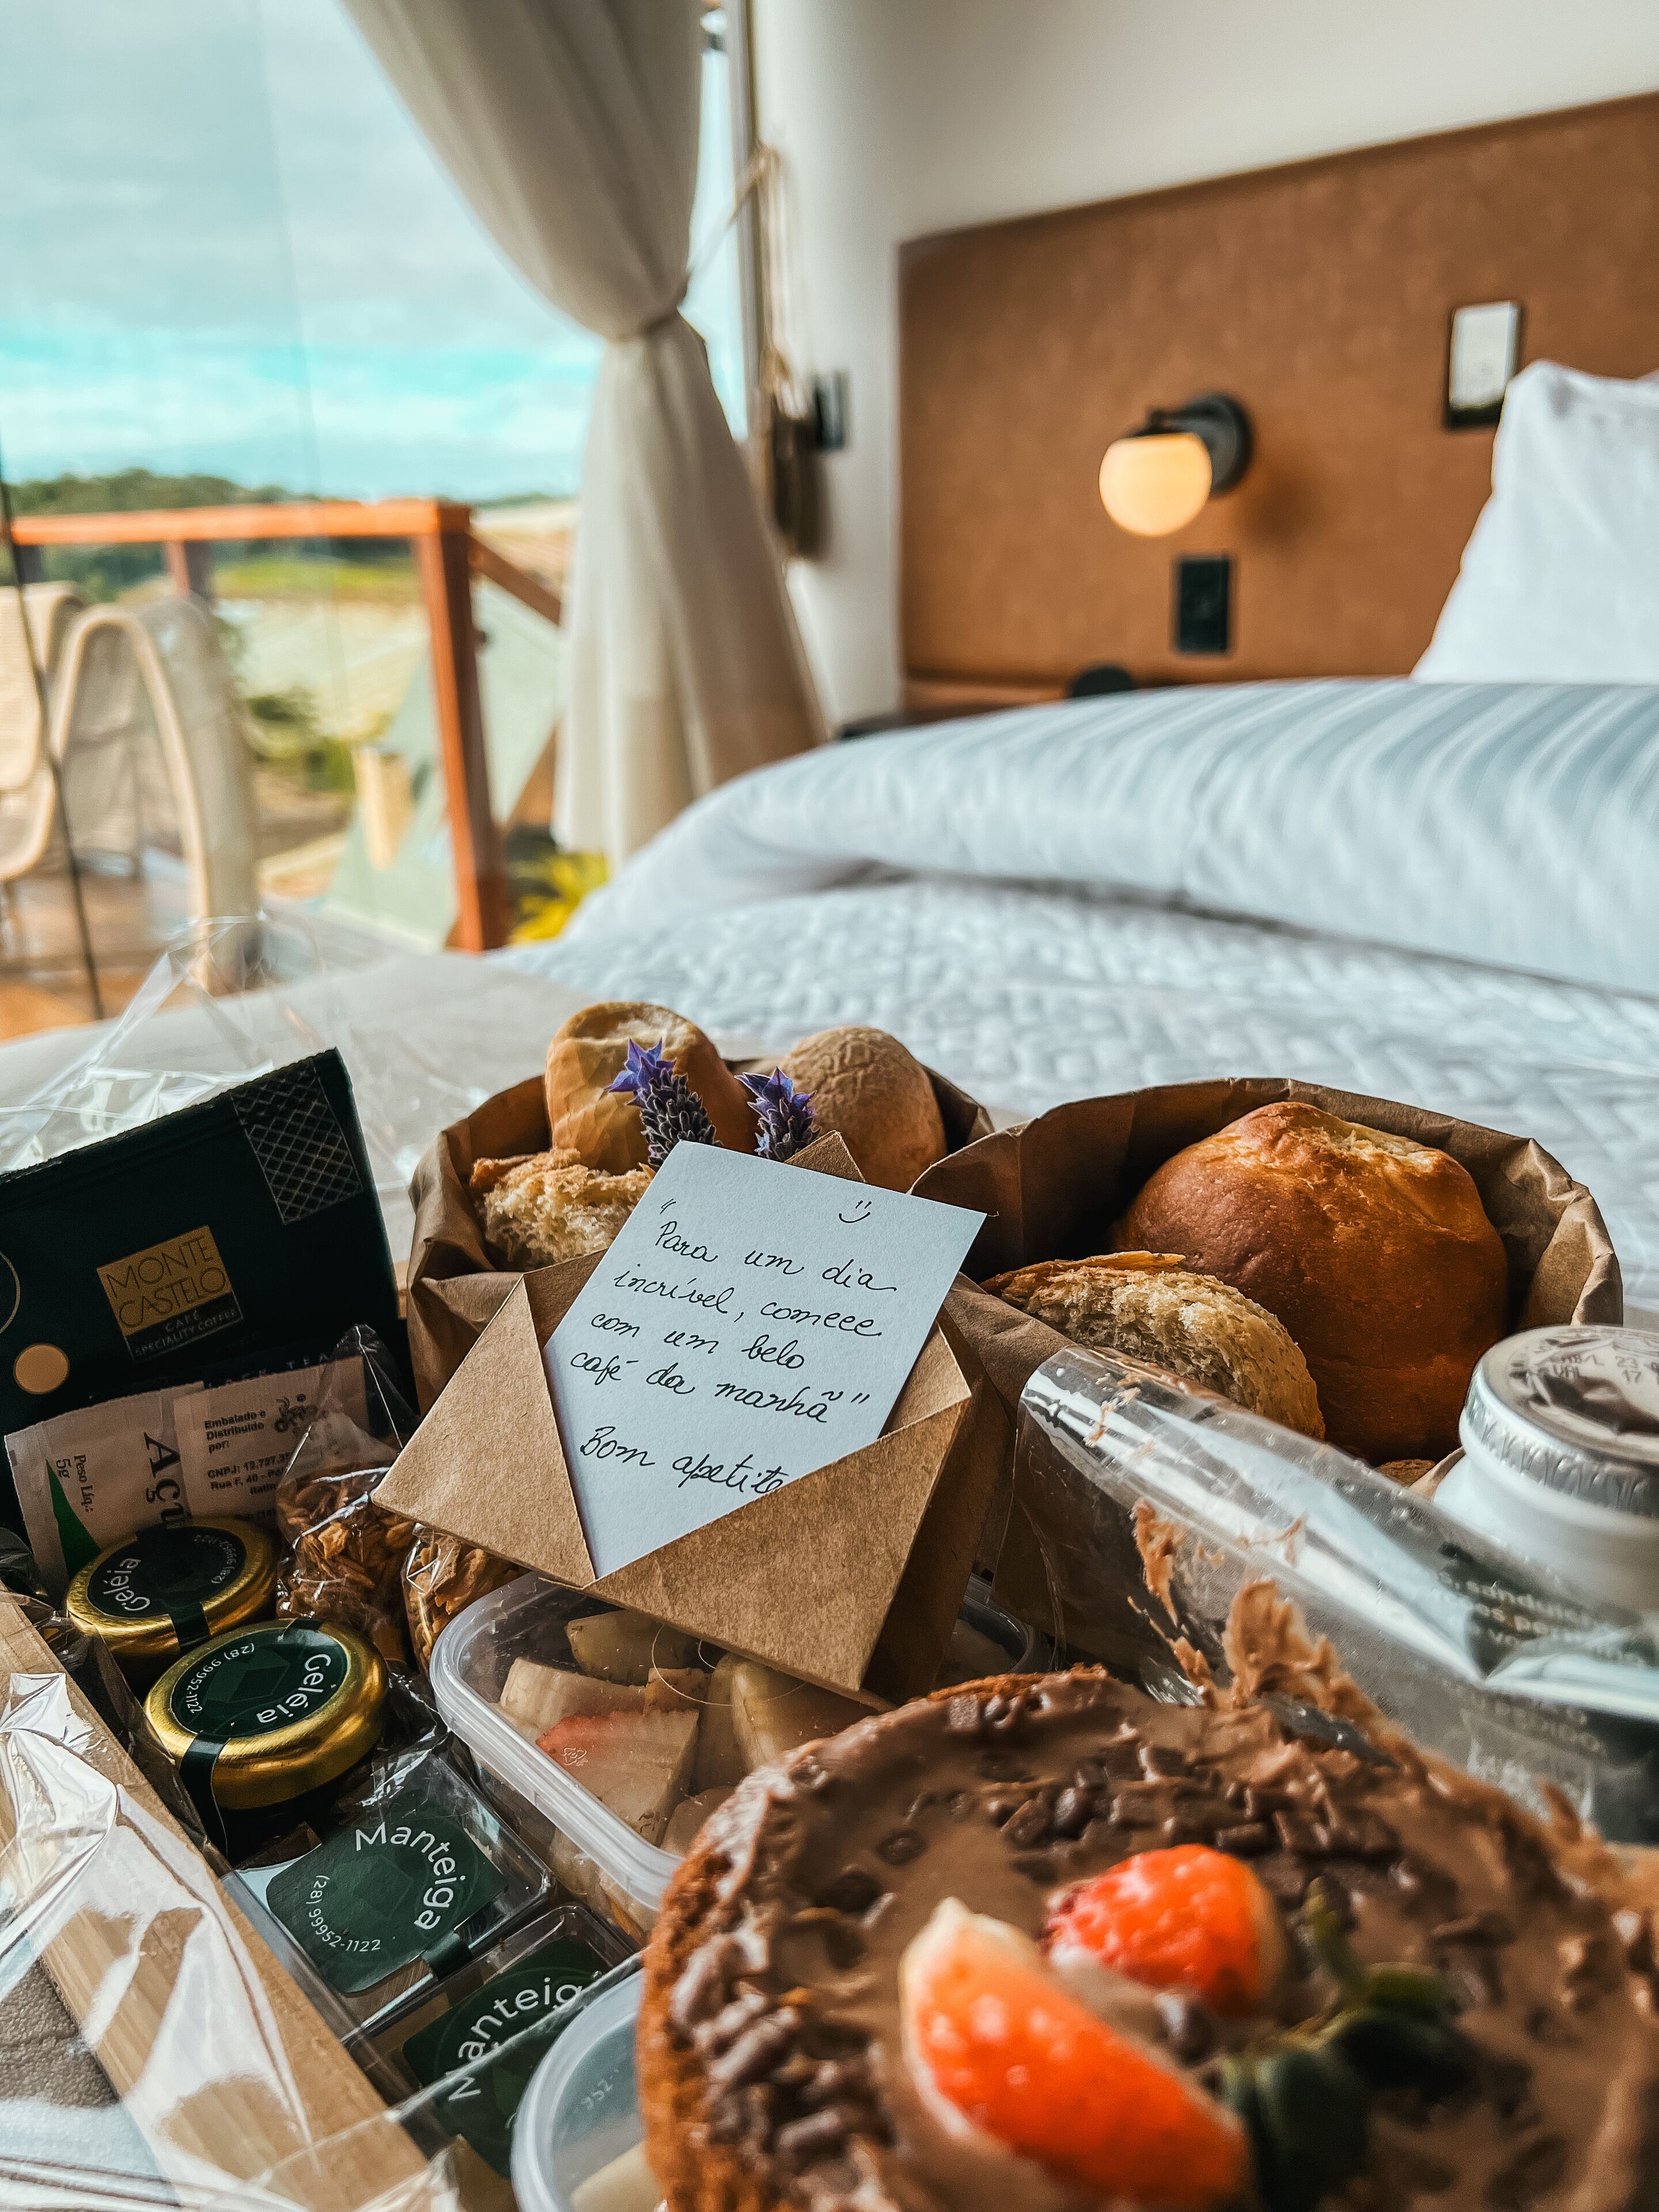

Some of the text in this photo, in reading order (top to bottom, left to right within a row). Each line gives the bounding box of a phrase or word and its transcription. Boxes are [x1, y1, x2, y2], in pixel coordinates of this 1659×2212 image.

[105, 1234, 214, 1298] MONTE
[744, 1249, 805, 1275] um
[822, 1259, 897, 1291] dia
[119, 1267, 226, 1327] CASTELO
[591, 1313, 806, 1370] com um belo
[570, 1350, 639, 1386] café
[646, 1362, 696, 1395] da
[74, 1454, 88, 1482] Peso
[580, 1426, 656, 1466] Bom
[102, 1558, 150, 1611] Geléia
[186, 1643, 255, 1714] (28) 99952-1122
[257, 1654, 332, 1723] Geléia
[354, 1821, 467, 1931] Manteiga
[305, 1874, 381, 1953] (28) 99952-1122
